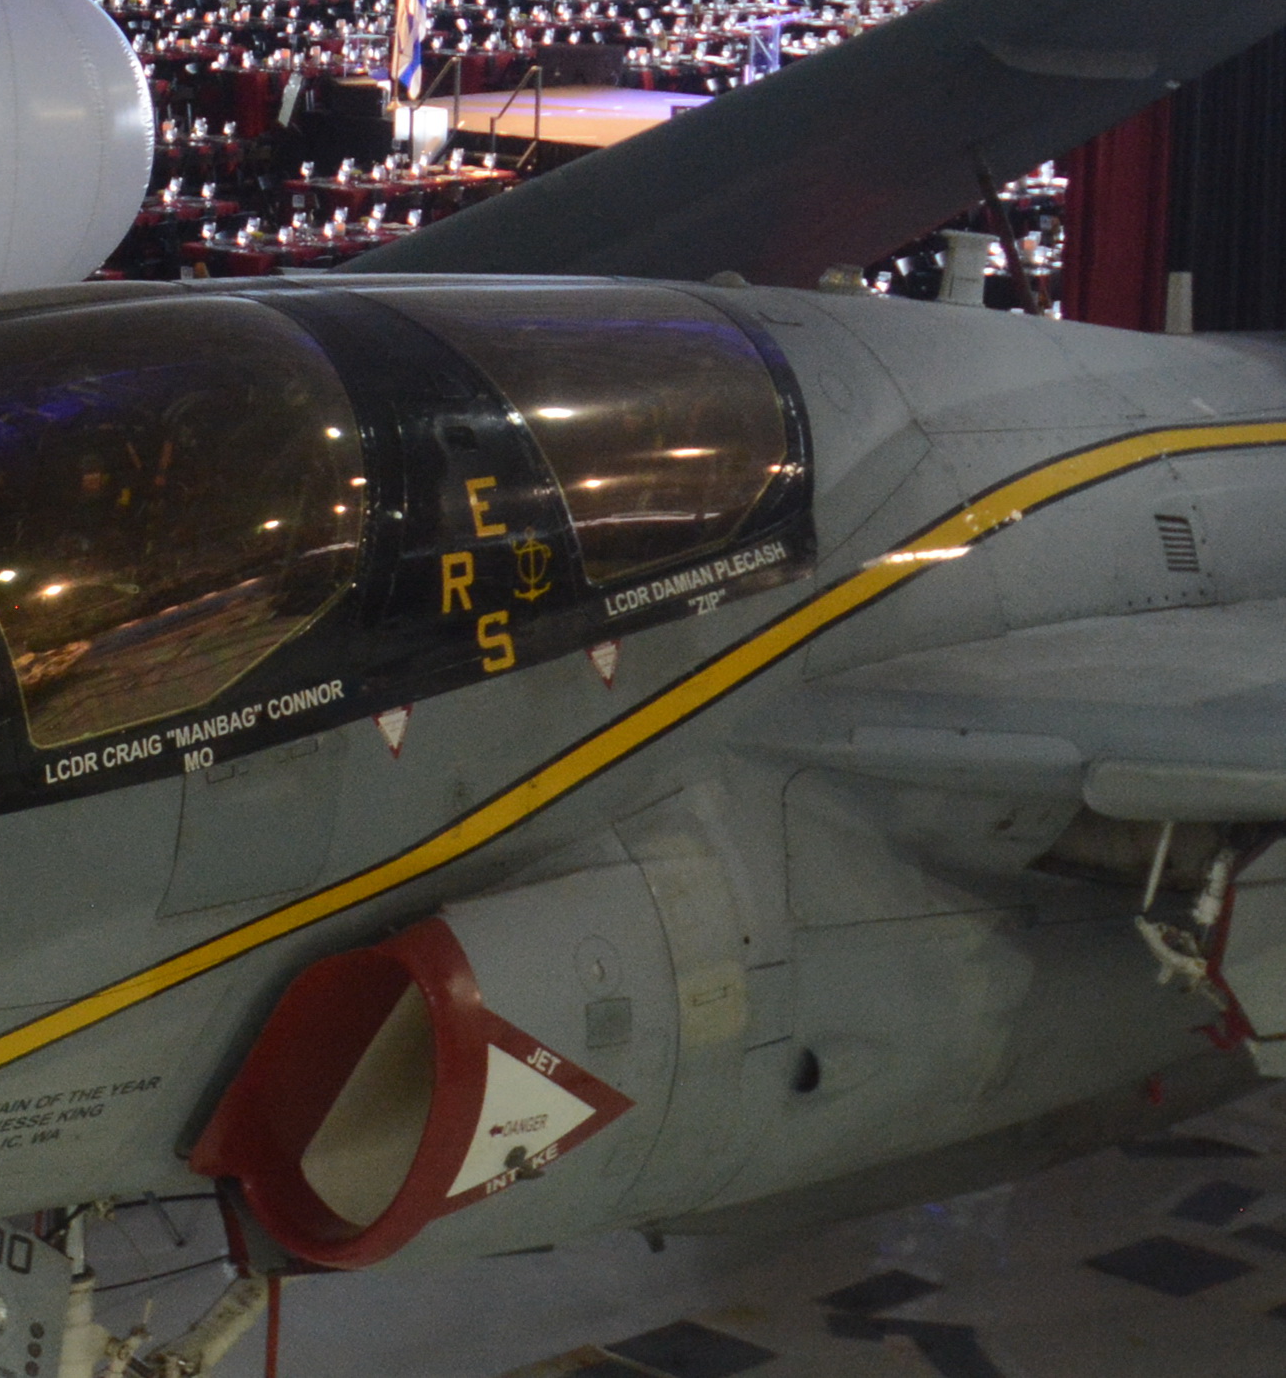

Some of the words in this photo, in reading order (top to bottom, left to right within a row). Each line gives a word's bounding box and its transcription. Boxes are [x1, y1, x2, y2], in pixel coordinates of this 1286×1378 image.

[465, 476, 507, 538] E
[441, 551, 474, 614] R
[605, 587, 652, 617] LCDR
[651, 565, 715, 601] DAMIAN
[713, 541, 787, 581] PLECASH
[478, 610, 516, 673] S
[45, 752, 98, 784] LCDR
[102, 735, 163, 768] CRAIG
[166, 704, 263, 749] "MANBAG"
[267, 679, 345, 720] CONNOR
[183, 747, 214, 772] MO
[527, 1047, 561, 1076] JET
[34, 1092, 65, 1111] OF
[69, 1085, 108, 1103] THE
[110, 1075, 163, 1096] YEAR
[58, 1104, 105, 1122] KING
[31, 1128, 61, 1145] WA
[503, 1114, 548, 1137] DANGER
[486, 1143, 560, 1195] INTKE
